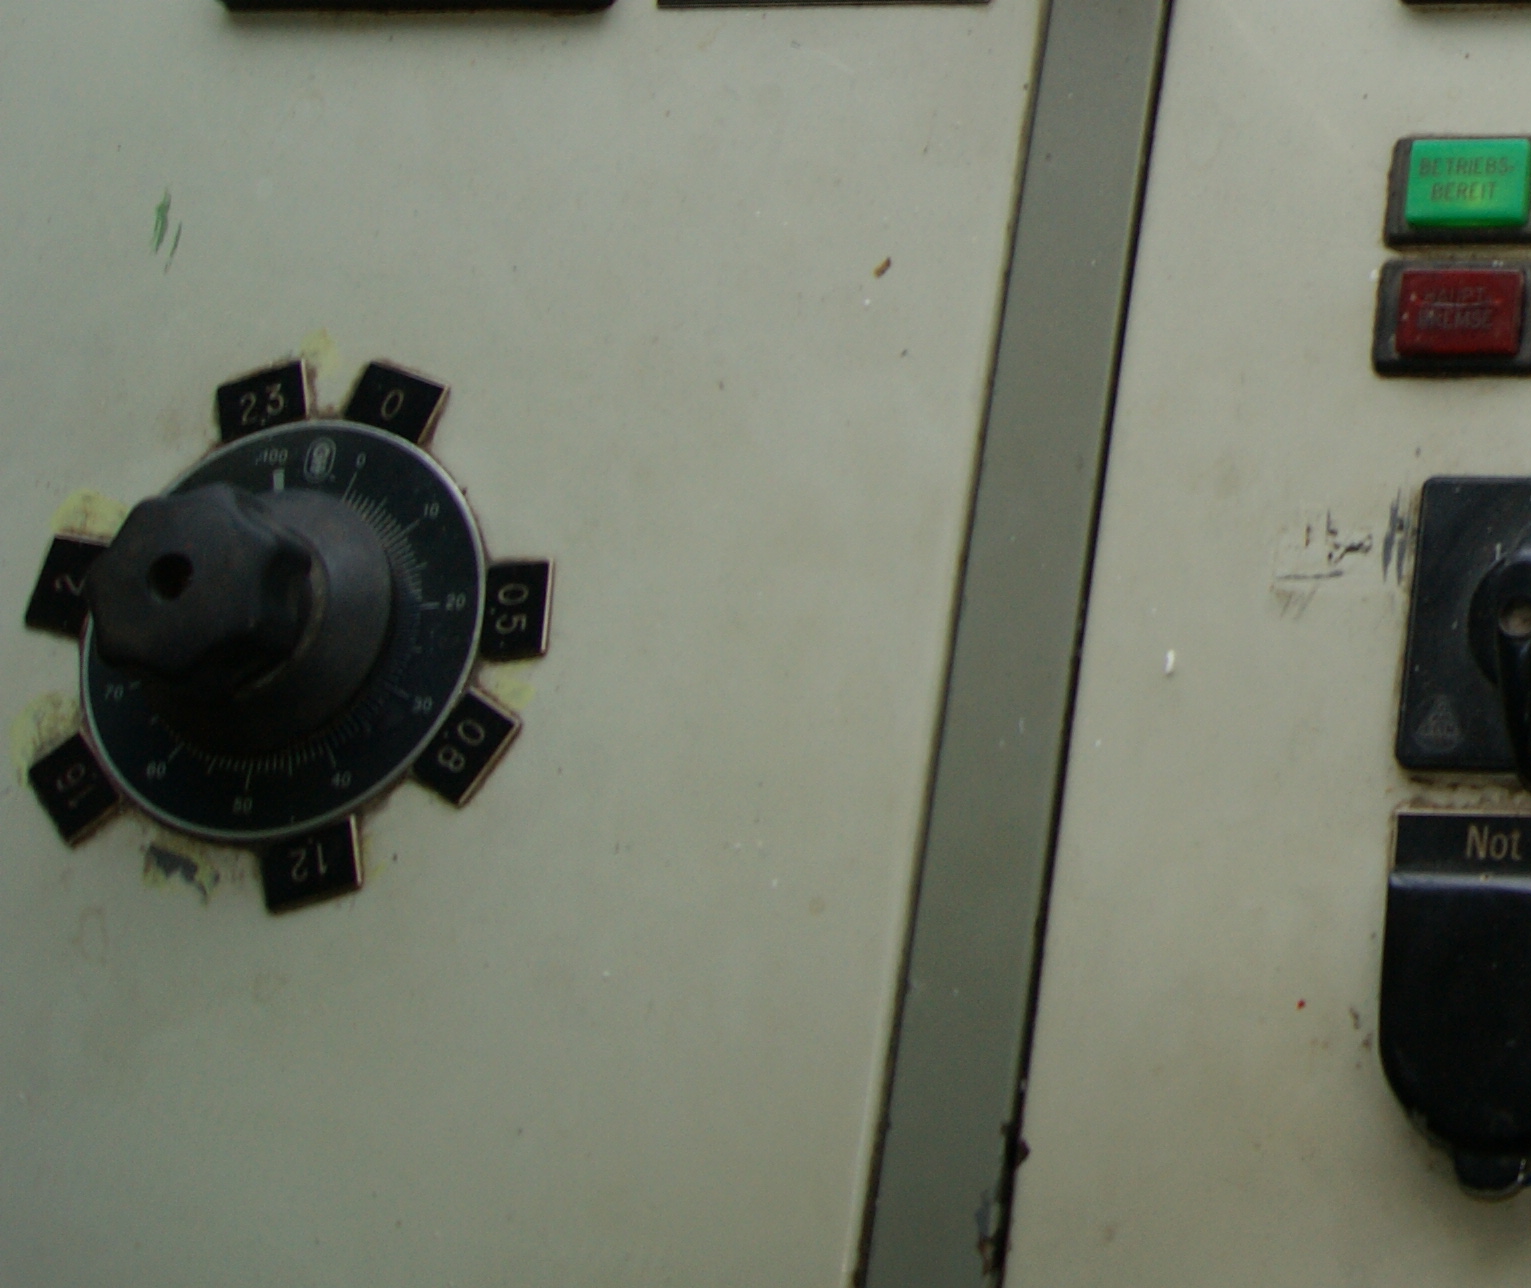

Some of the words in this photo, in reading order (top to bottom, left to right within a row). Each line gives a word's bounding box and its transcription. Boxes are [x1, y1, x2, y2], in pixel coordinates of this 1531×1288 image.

[1419, 156, 1516, 179] BETRIEBS-
[1430, 181, 1498, 203] BEREIT
[381, 388, 405, 420] 0
[424, 503, 440, 519] 10
[446, 593, 466, 610] 20
[104, 683, 125, 701] 70
[1466, 825, 1522, 862] Not
